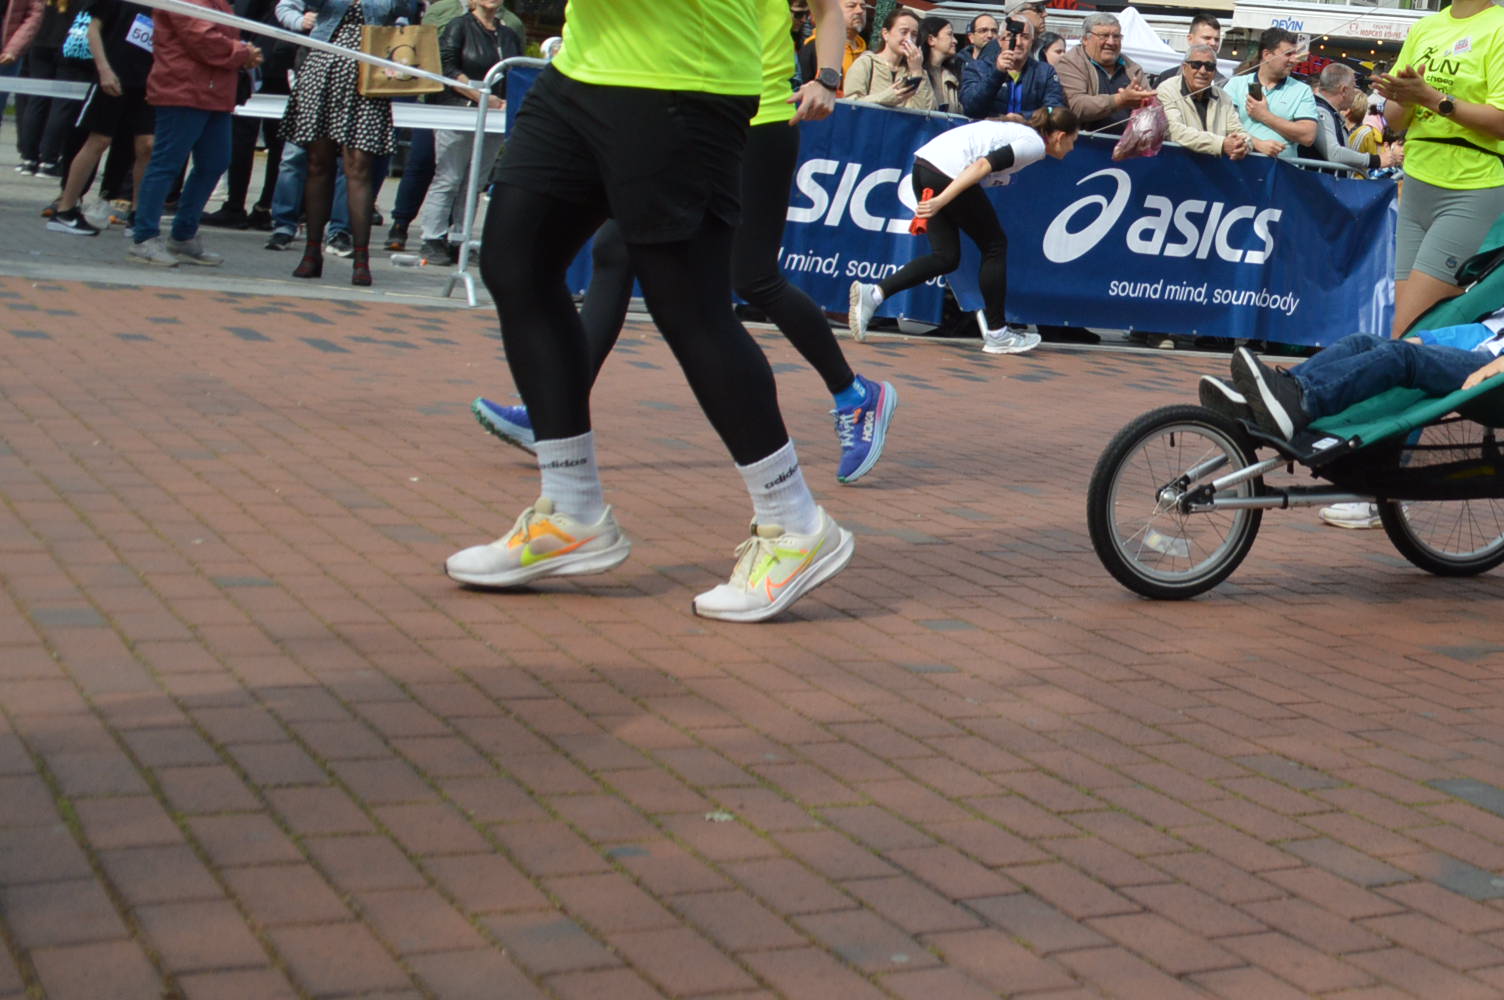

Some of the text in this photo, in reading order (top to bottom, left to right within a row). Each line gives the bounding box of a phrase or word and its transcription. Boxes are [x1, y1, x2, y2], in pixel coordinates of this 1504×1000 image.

[1126, 194, 1283, 265] asics
[784, 250, 840, 278] mind,
[1108, 279, 1164, 300] sound
[1164, 282, 1207, 305] mind,
[862, 411, 875, 442] HOKA
